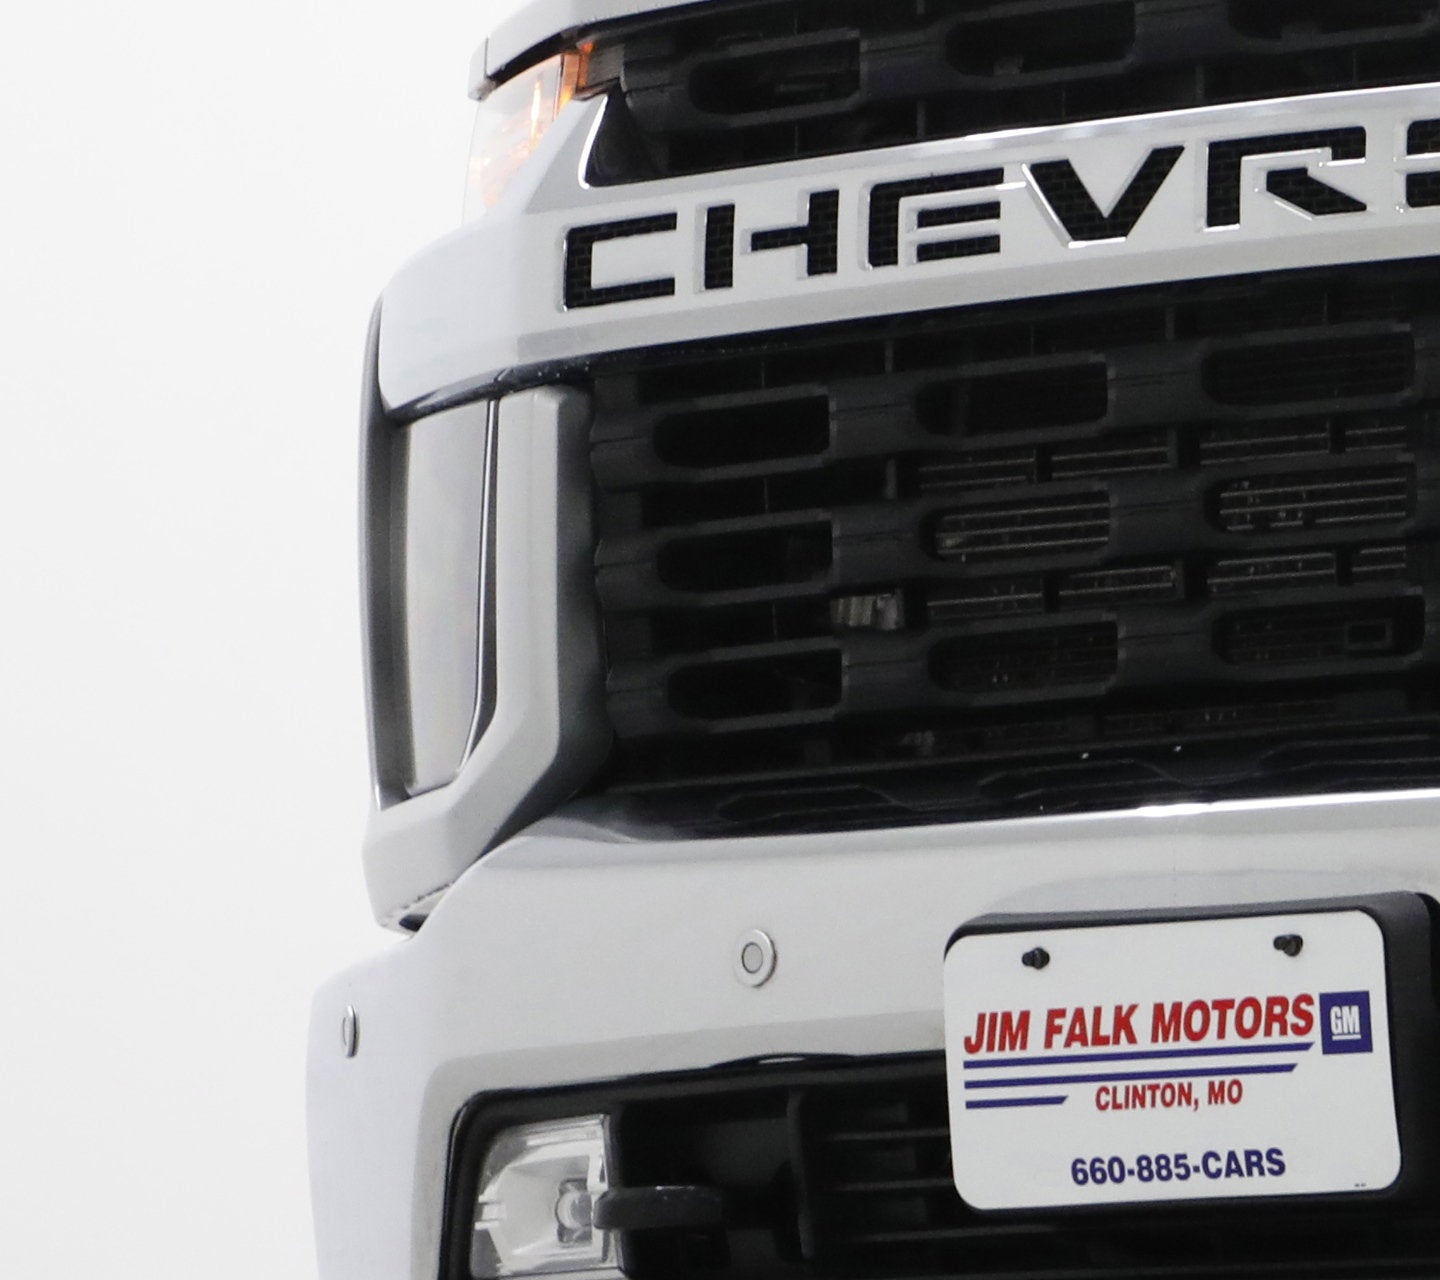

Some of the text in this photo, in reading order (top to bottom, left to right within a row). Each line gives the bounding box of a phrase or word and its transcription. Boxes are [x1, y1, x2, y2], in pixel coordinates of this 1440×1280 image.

[963, 993, 1315, 1055] JIM FALK MOTORS
[1330, 1005, 1361, 1036] GM
[1094, 1079, 1244, 1112] CLINTON, MO
[1070, 1147, 1286, 1186] 660-885-CARS
